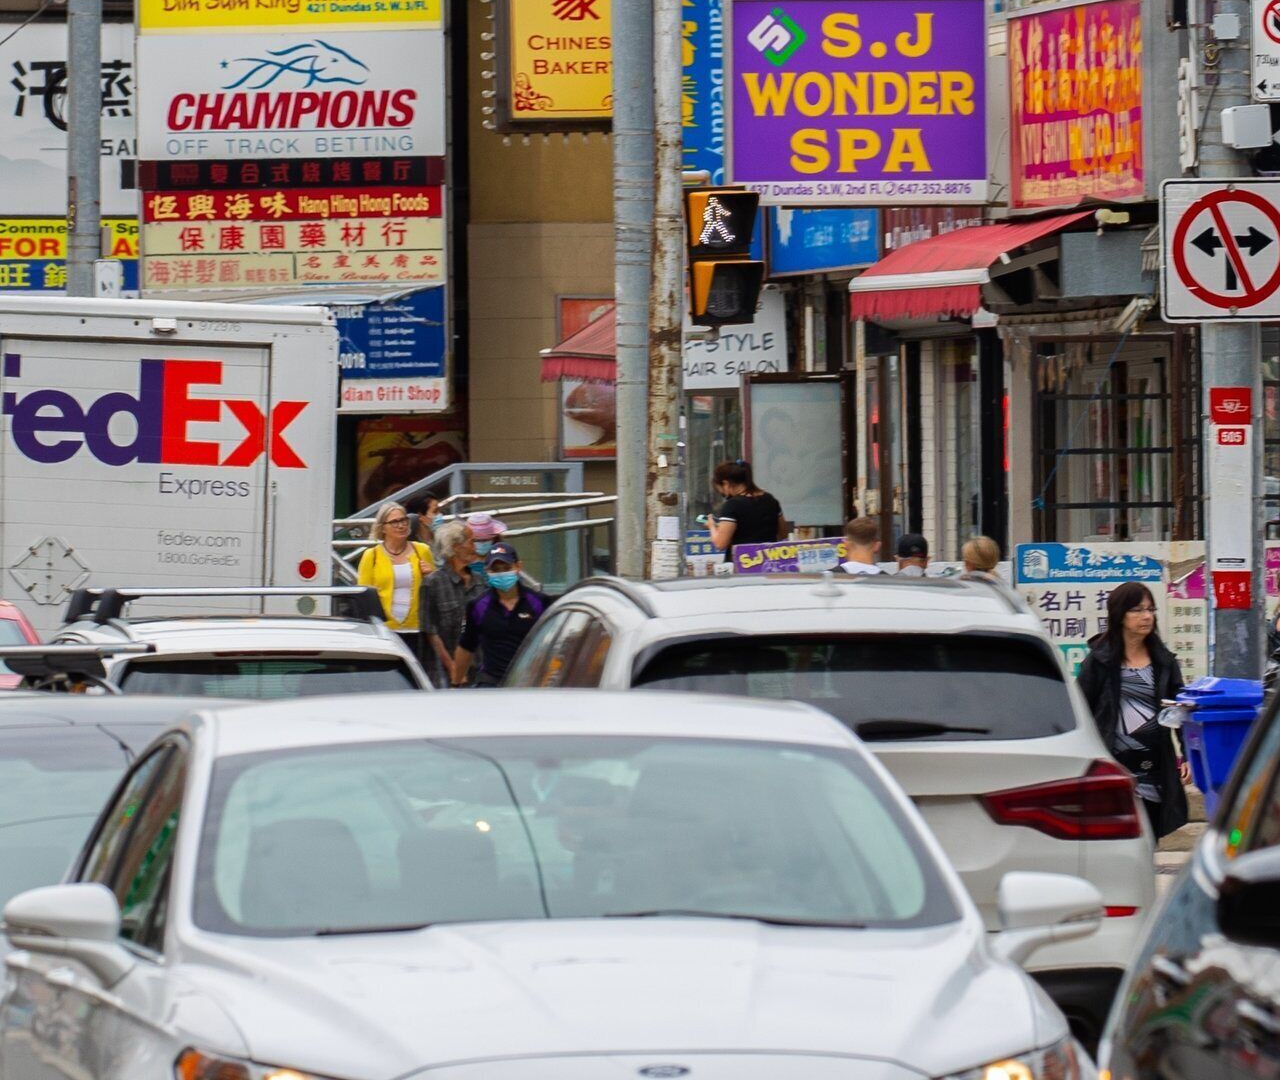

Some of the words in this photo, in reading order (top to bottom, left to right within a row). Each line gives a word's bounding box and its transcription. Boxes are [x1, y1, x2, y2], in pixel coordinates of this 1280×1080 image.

[306, 3, 326, 13] 421
[330, 2, 371, 12] Dundas
[527, 35, 611, 50] CHINES
[821, 13, 934, 58] S.J
[533, 59, 612, 75] BAKER
[741, 70, 976, 117] WONDER
[166, 88, 417, 131] CHAMPIONS
[167, 139, 208, 155] OFF
[224, 138, 300, 154] TRACK
[314, 135, 414, 153] BETTING
[790, 128, 932, 174] SPA
[772, 183, 814, 197] Dundas
[846, 182, 866, 195] 2nd
[898, 181, 972, 195] 647-352-8876
[148, 191, 293, 220] 恆興海味
[298, 195, 329, 217] Hang
[331, 195, 359, 216] Hing
[360, 194, 390, 215] Hong
[392, 192, 430, 211] Foods
[178, 221, 408, 251] 保康園藥材行
[343, 386, 373, 401] dian
[377, 385, 404, 401] Gift
[407, 385, 442, 404] Shop
[159, 472, 250, 499] Express
[157, 530, 242, 549] fedex.com
[1039, 590, 1085, 611] 名片
